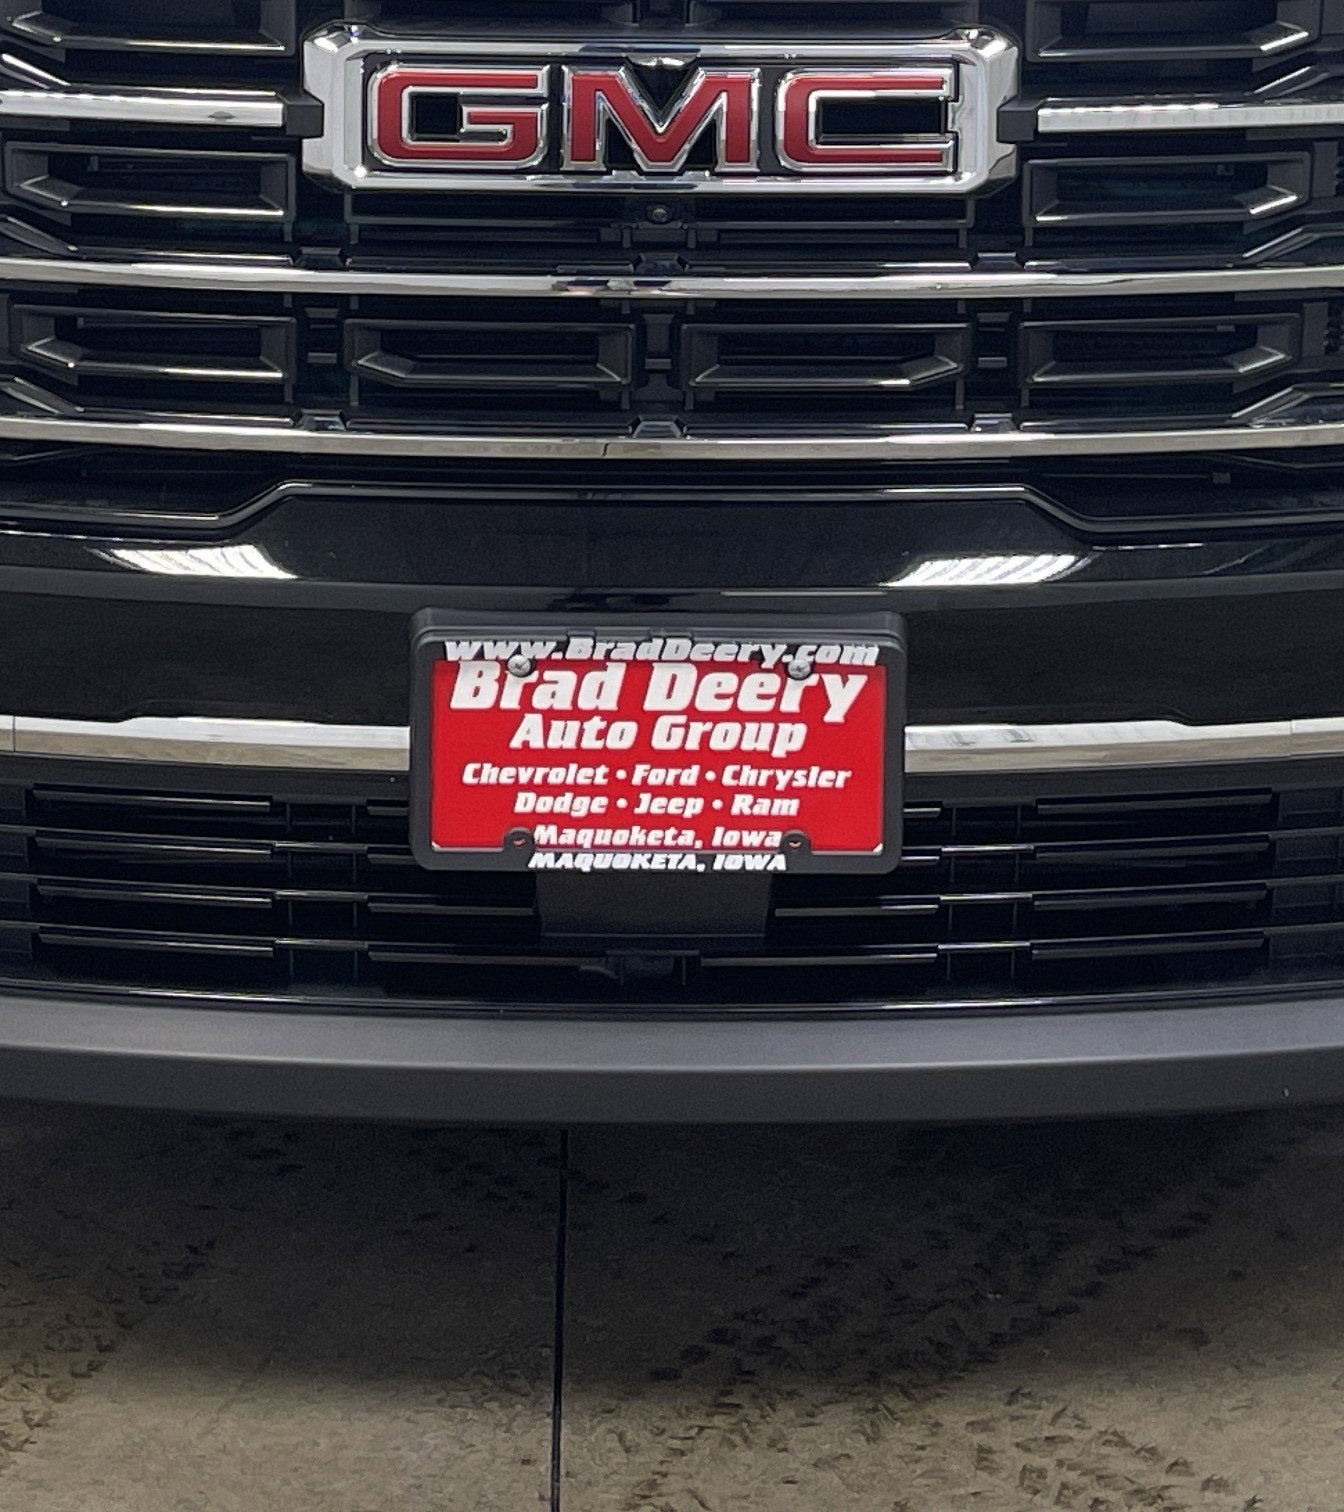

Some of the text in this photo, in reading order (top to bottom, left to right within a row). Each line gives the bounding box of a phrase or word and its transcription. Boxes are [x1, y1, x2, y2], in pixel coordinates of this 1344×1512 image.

[372, 64, 954, 172] GMC
[444, 635, 880, 668] www.BradDeery.com
[449, 659, 868, 723] Brad Deery
[508, 714, 808, 758] Auto Group
[462, 763, 852, 791] Chevrolet Ford Chrysler
[514, 792, 800, 818] Dodge Jeep Ram
[534, 825, 783, 848] Maquoketa, Iowa
[528, 852, 787, 872] MAQUOKETA, IOWA
